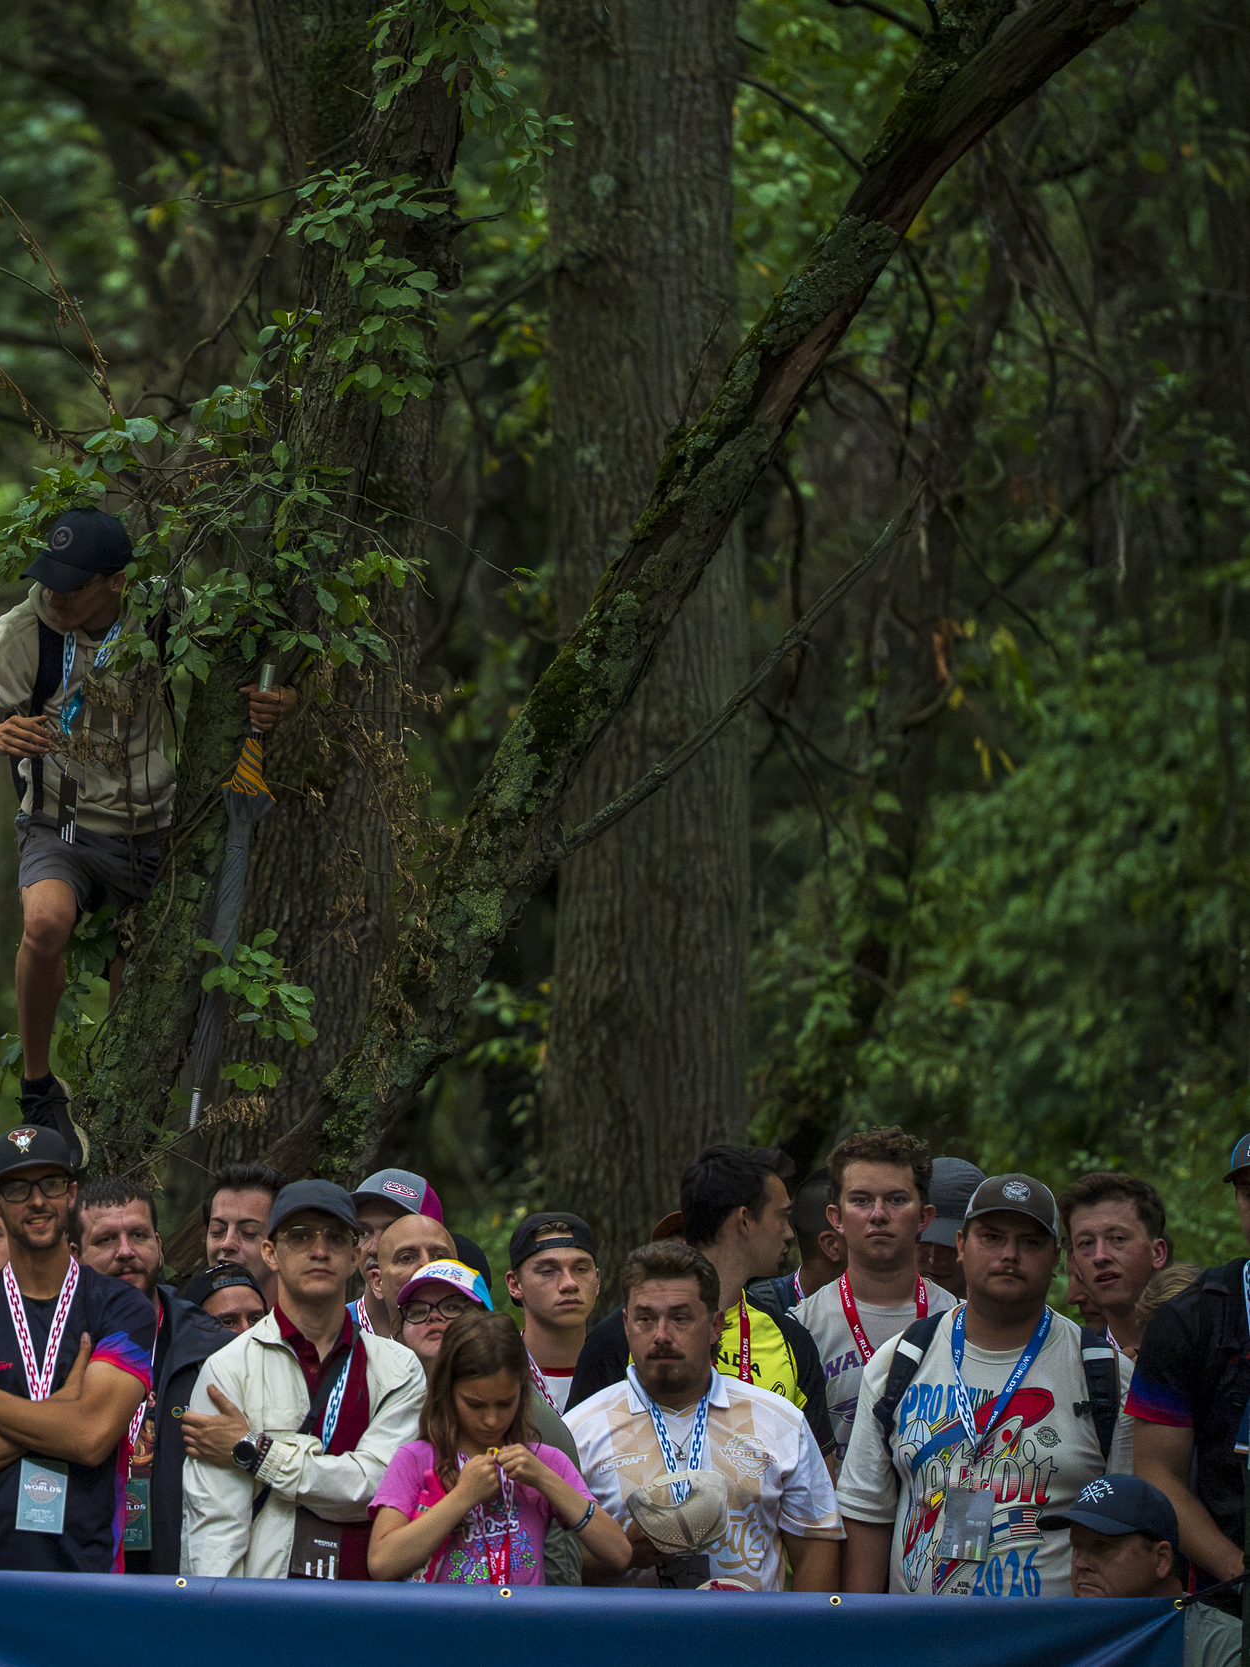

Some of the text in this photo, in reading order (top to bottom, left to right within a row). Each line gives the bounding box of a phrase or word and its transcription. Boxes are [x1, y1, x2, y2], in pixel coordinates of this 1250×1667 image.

[1005, 1355, 1031, 1393] WORLDS
[898, 1383, 943, 1437] PRO
[599, 1453, 650, 1475] DISCRAFT
[24, 1483, 62, 1493] WORLDS
[971, 1547, 1041, 1597] 2026
